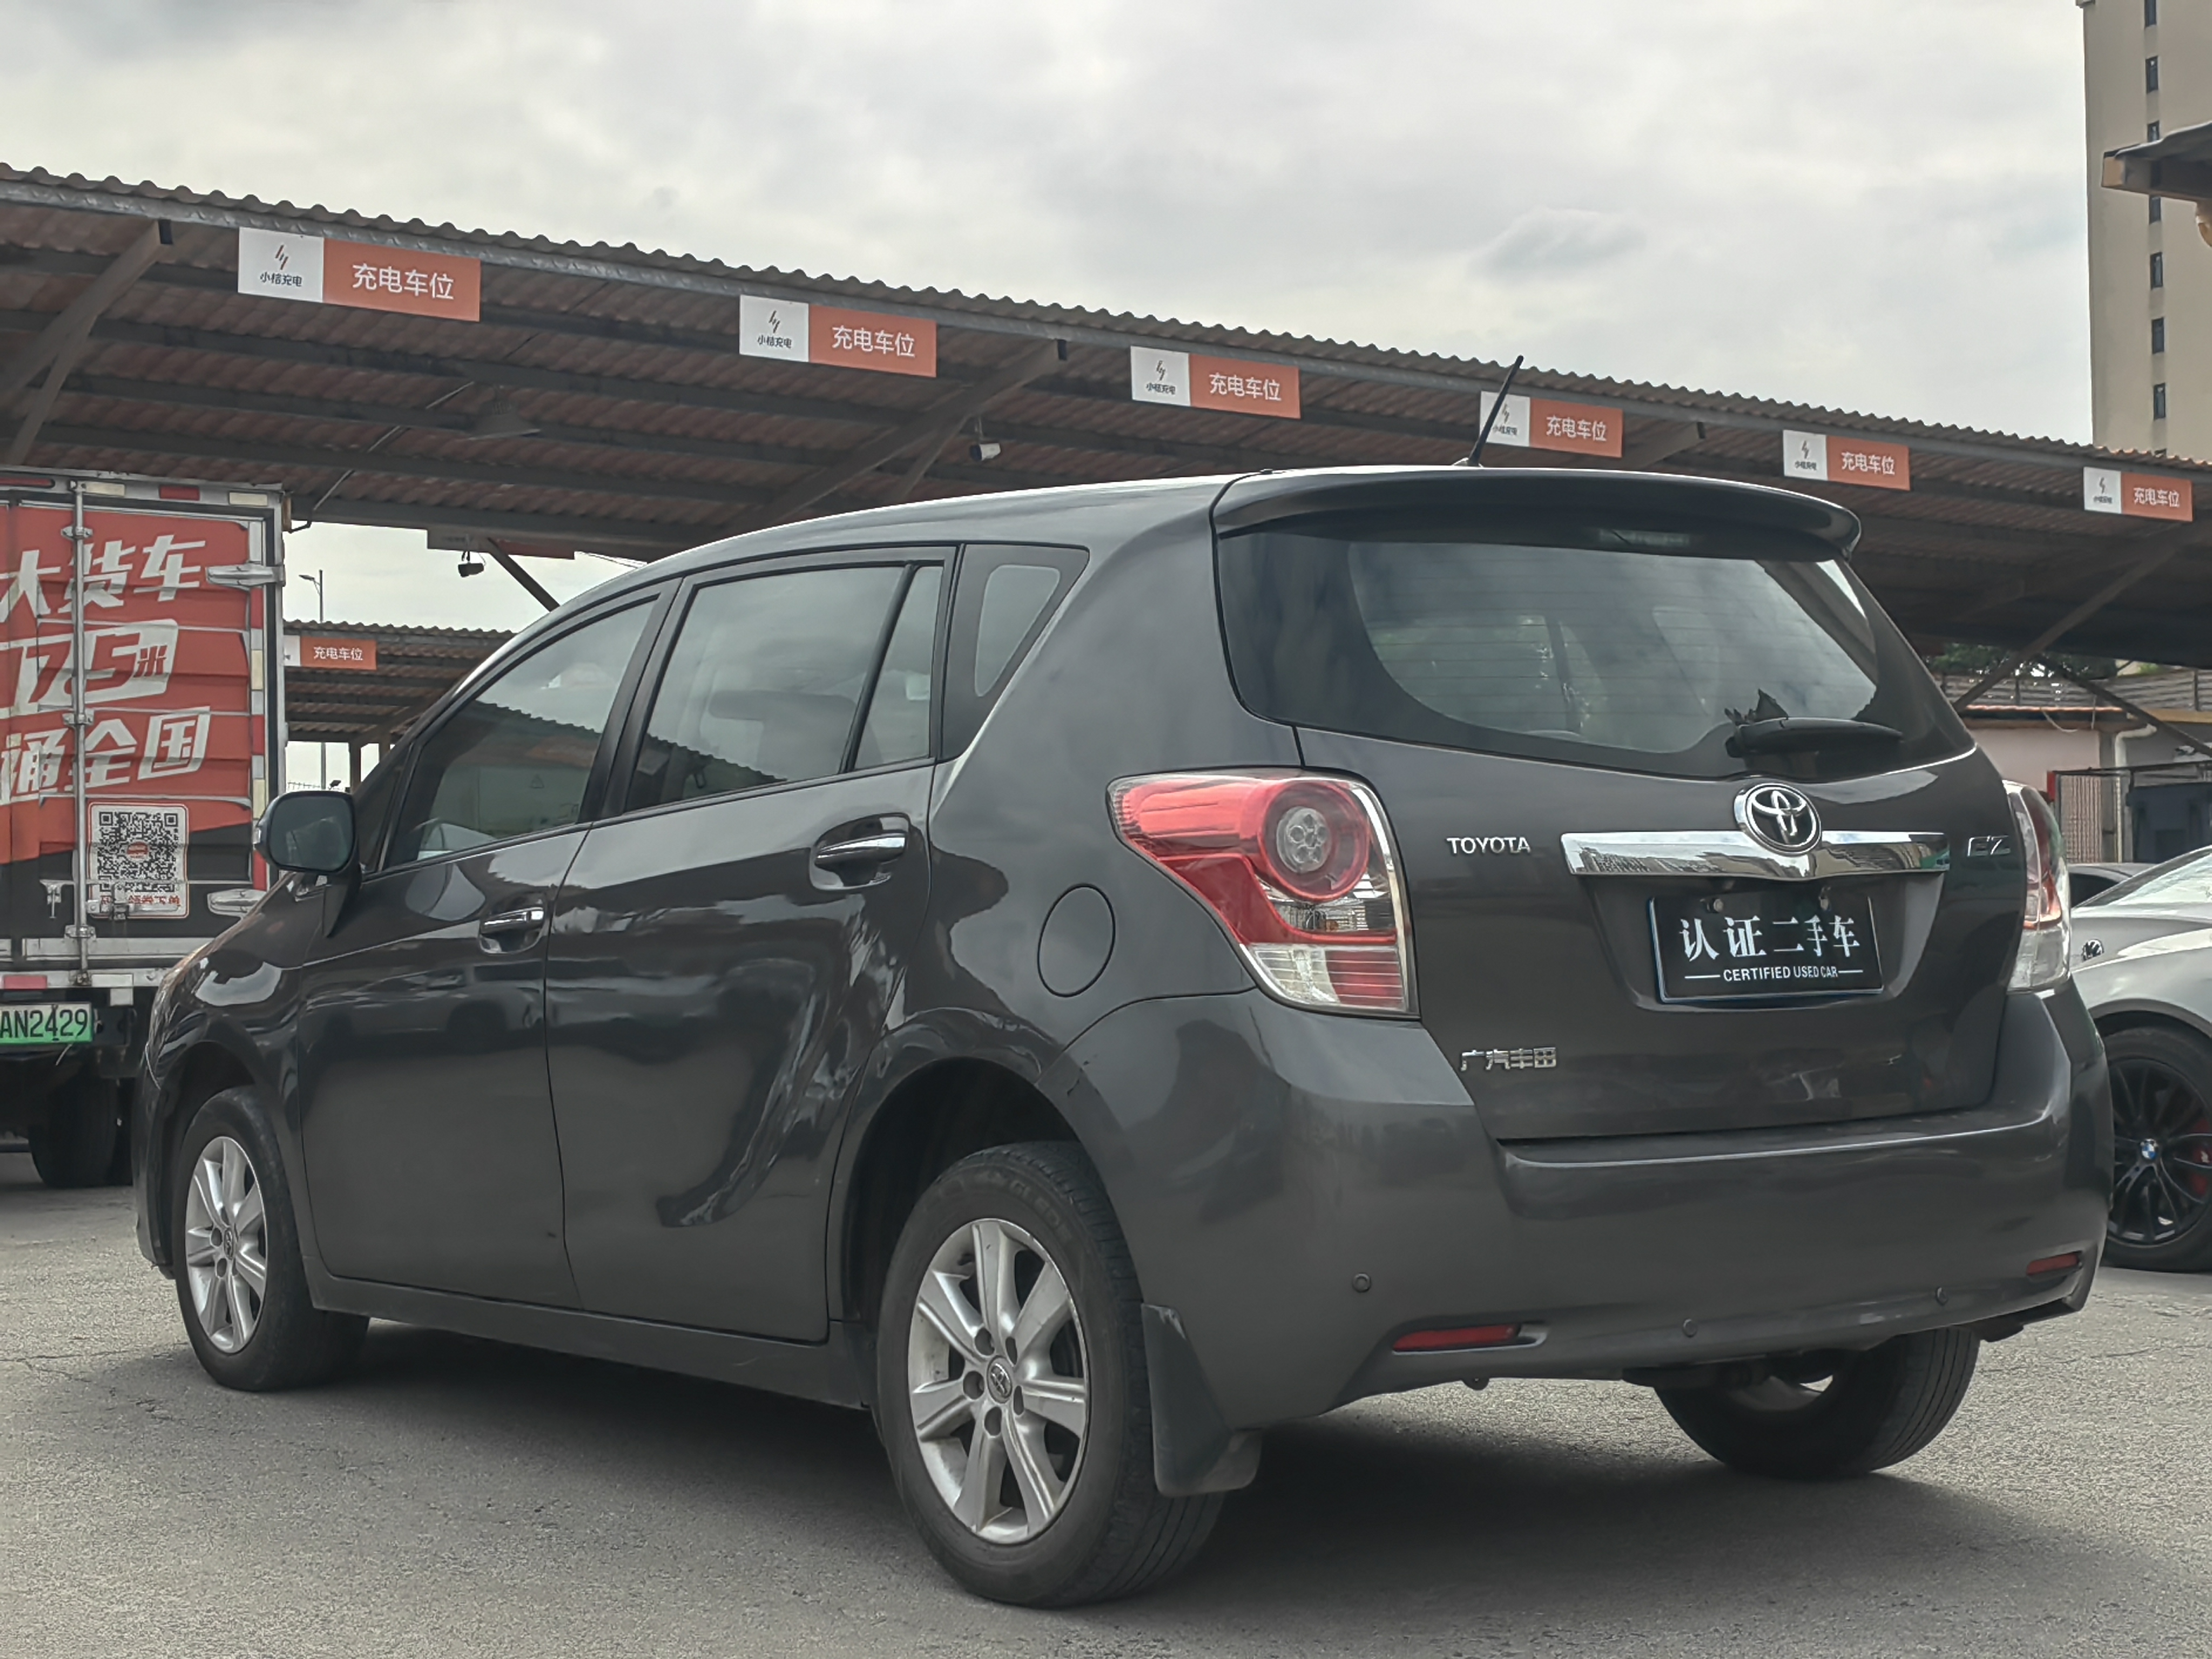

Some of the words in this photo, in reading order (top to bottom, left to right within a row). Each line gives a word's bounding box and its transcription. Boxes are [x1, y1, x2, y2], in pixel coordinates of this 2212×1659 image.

[260, 272, 303, 287] 小桔充电
[352, 262, 455, 300] 充电车位
[757, 334, 792, 349] 小桔充电
[832, 325, 916, 358] 充电车位
[1209, 372, 1282, 401] 充电车位
[1546, 415, 1607, 441] 充电车位
[1841, 451, 1895, 475] 充电车位
[2134, 487, 2180, 508] 充电车位
[313, 646, 363, 660] 充电车位
[1446, 837, 1531, 854] TOYOTA
[1678, 915, 1860, 962] 认证二手车
[1723, 966, 1791, 981] CERTIFIED
[1793, 965, 1819, 978] USED
[1820, 965, 1838, 978] CAR
[0, 1008, 88, 1038] AN2429
